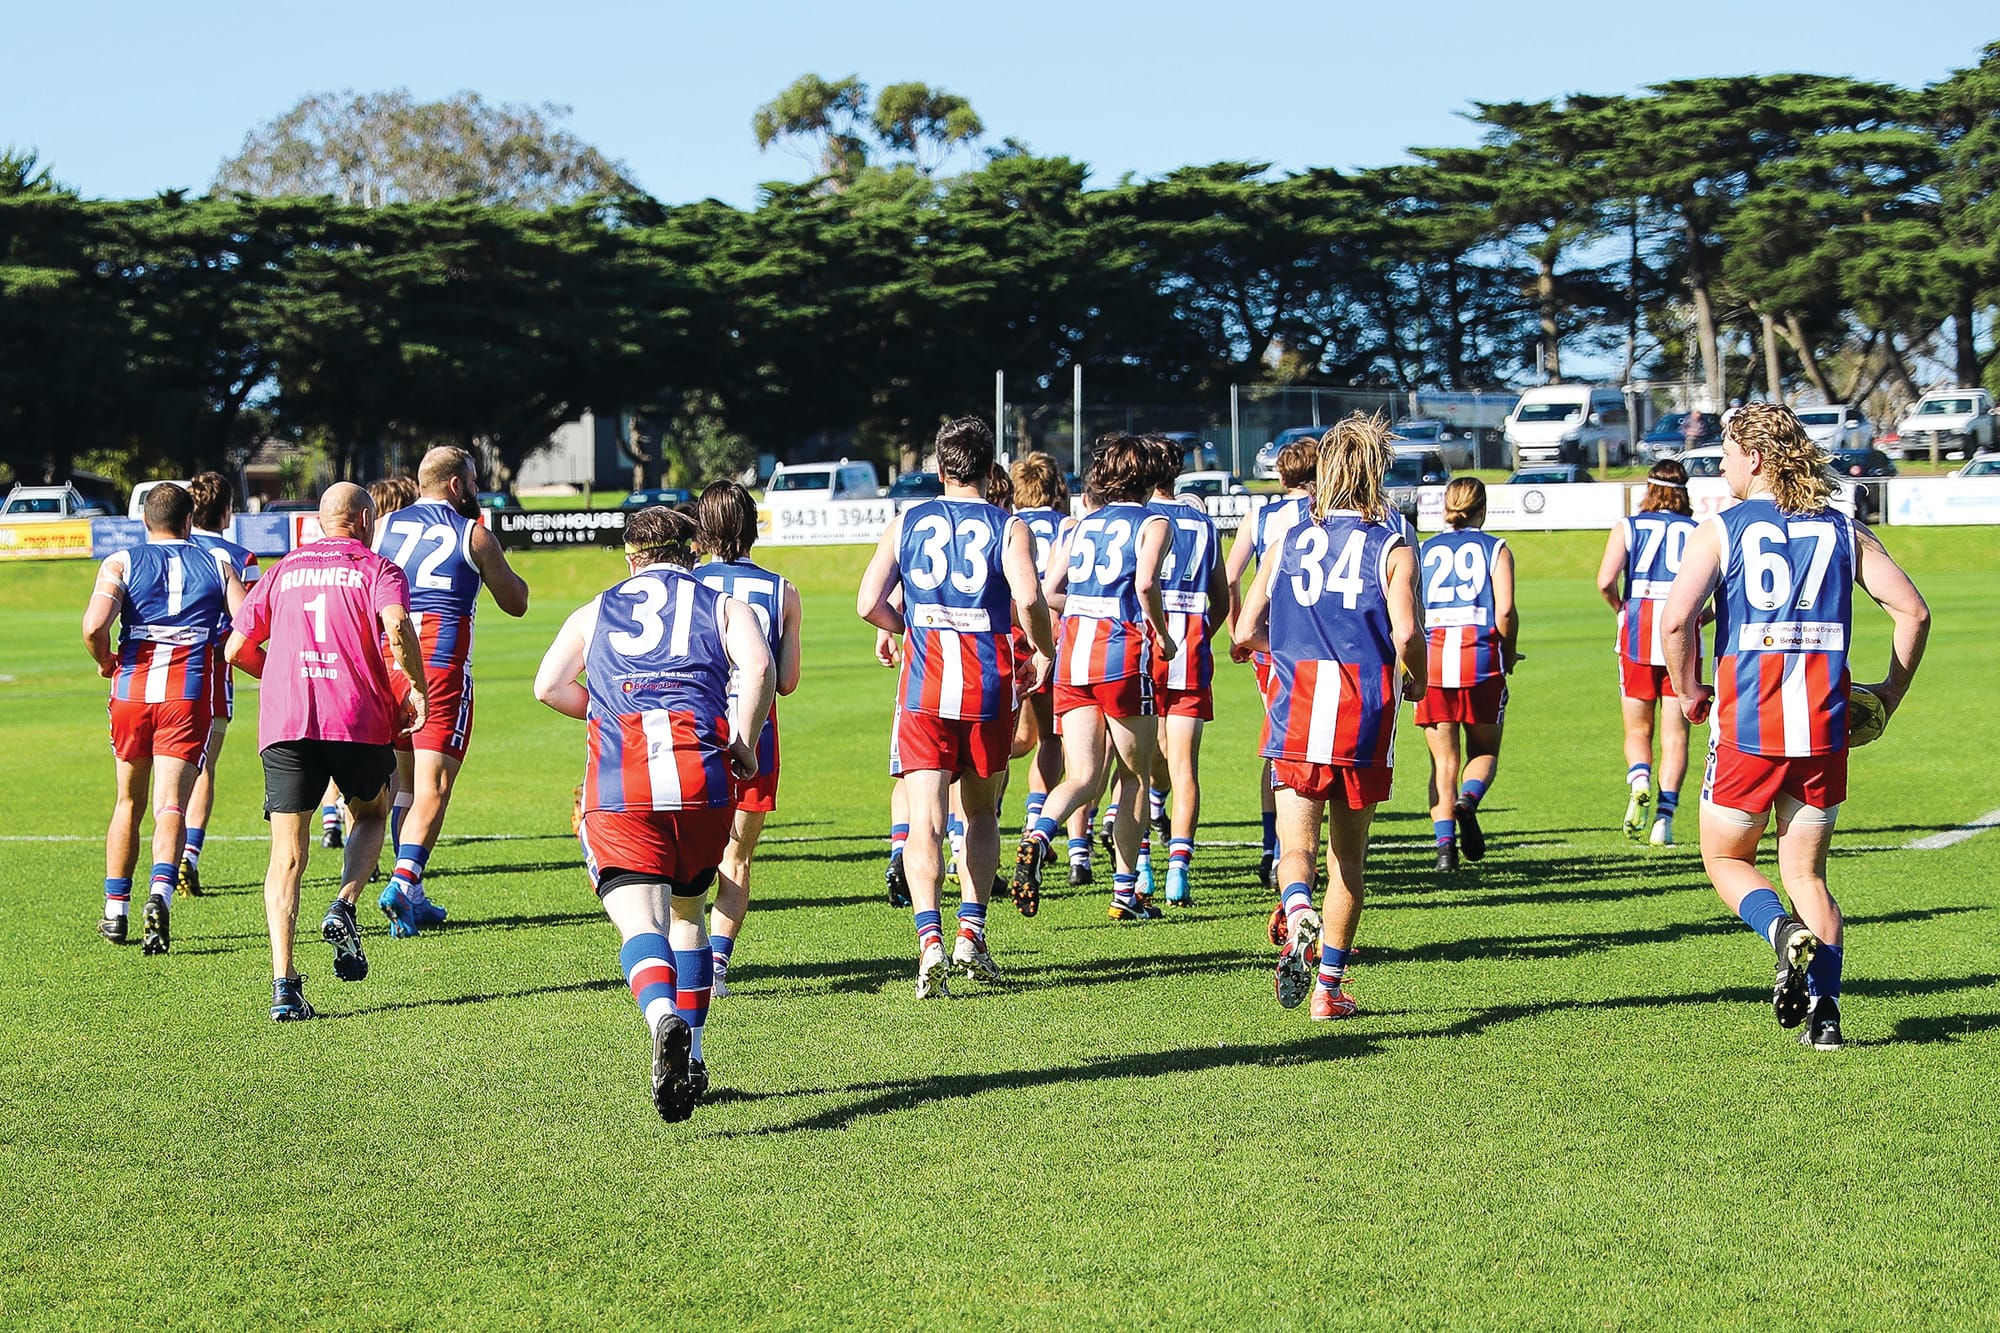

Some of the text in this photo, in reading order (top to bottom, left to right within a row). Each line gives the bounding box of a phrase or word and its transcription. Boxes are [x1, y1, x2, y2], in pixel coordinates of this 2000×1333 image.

[501, 512, 625, 531] LINENHOUSE
[531, 531, 596, 543] OUTLET
[781, 507, 886, 528] 9431 3944
[1634, 519, 1697, 574] 70
[281, 567, 363, 592] RUNNER
[390, 521, 457, 590] 72
[911, 515, 991, 594] 33
[1067, 519, 1131, 586] 53
[1290, 527, 1367, 610] 34
[1423, 542, 1487, 603] 29
[1741, 521, 1837, 611] 67
[167, 556, 182, 616] 1
[304, 593, 326, 642] 1
[608, 576, 696, 657] 31
[300, 651, 338, 664] PHILLIP
